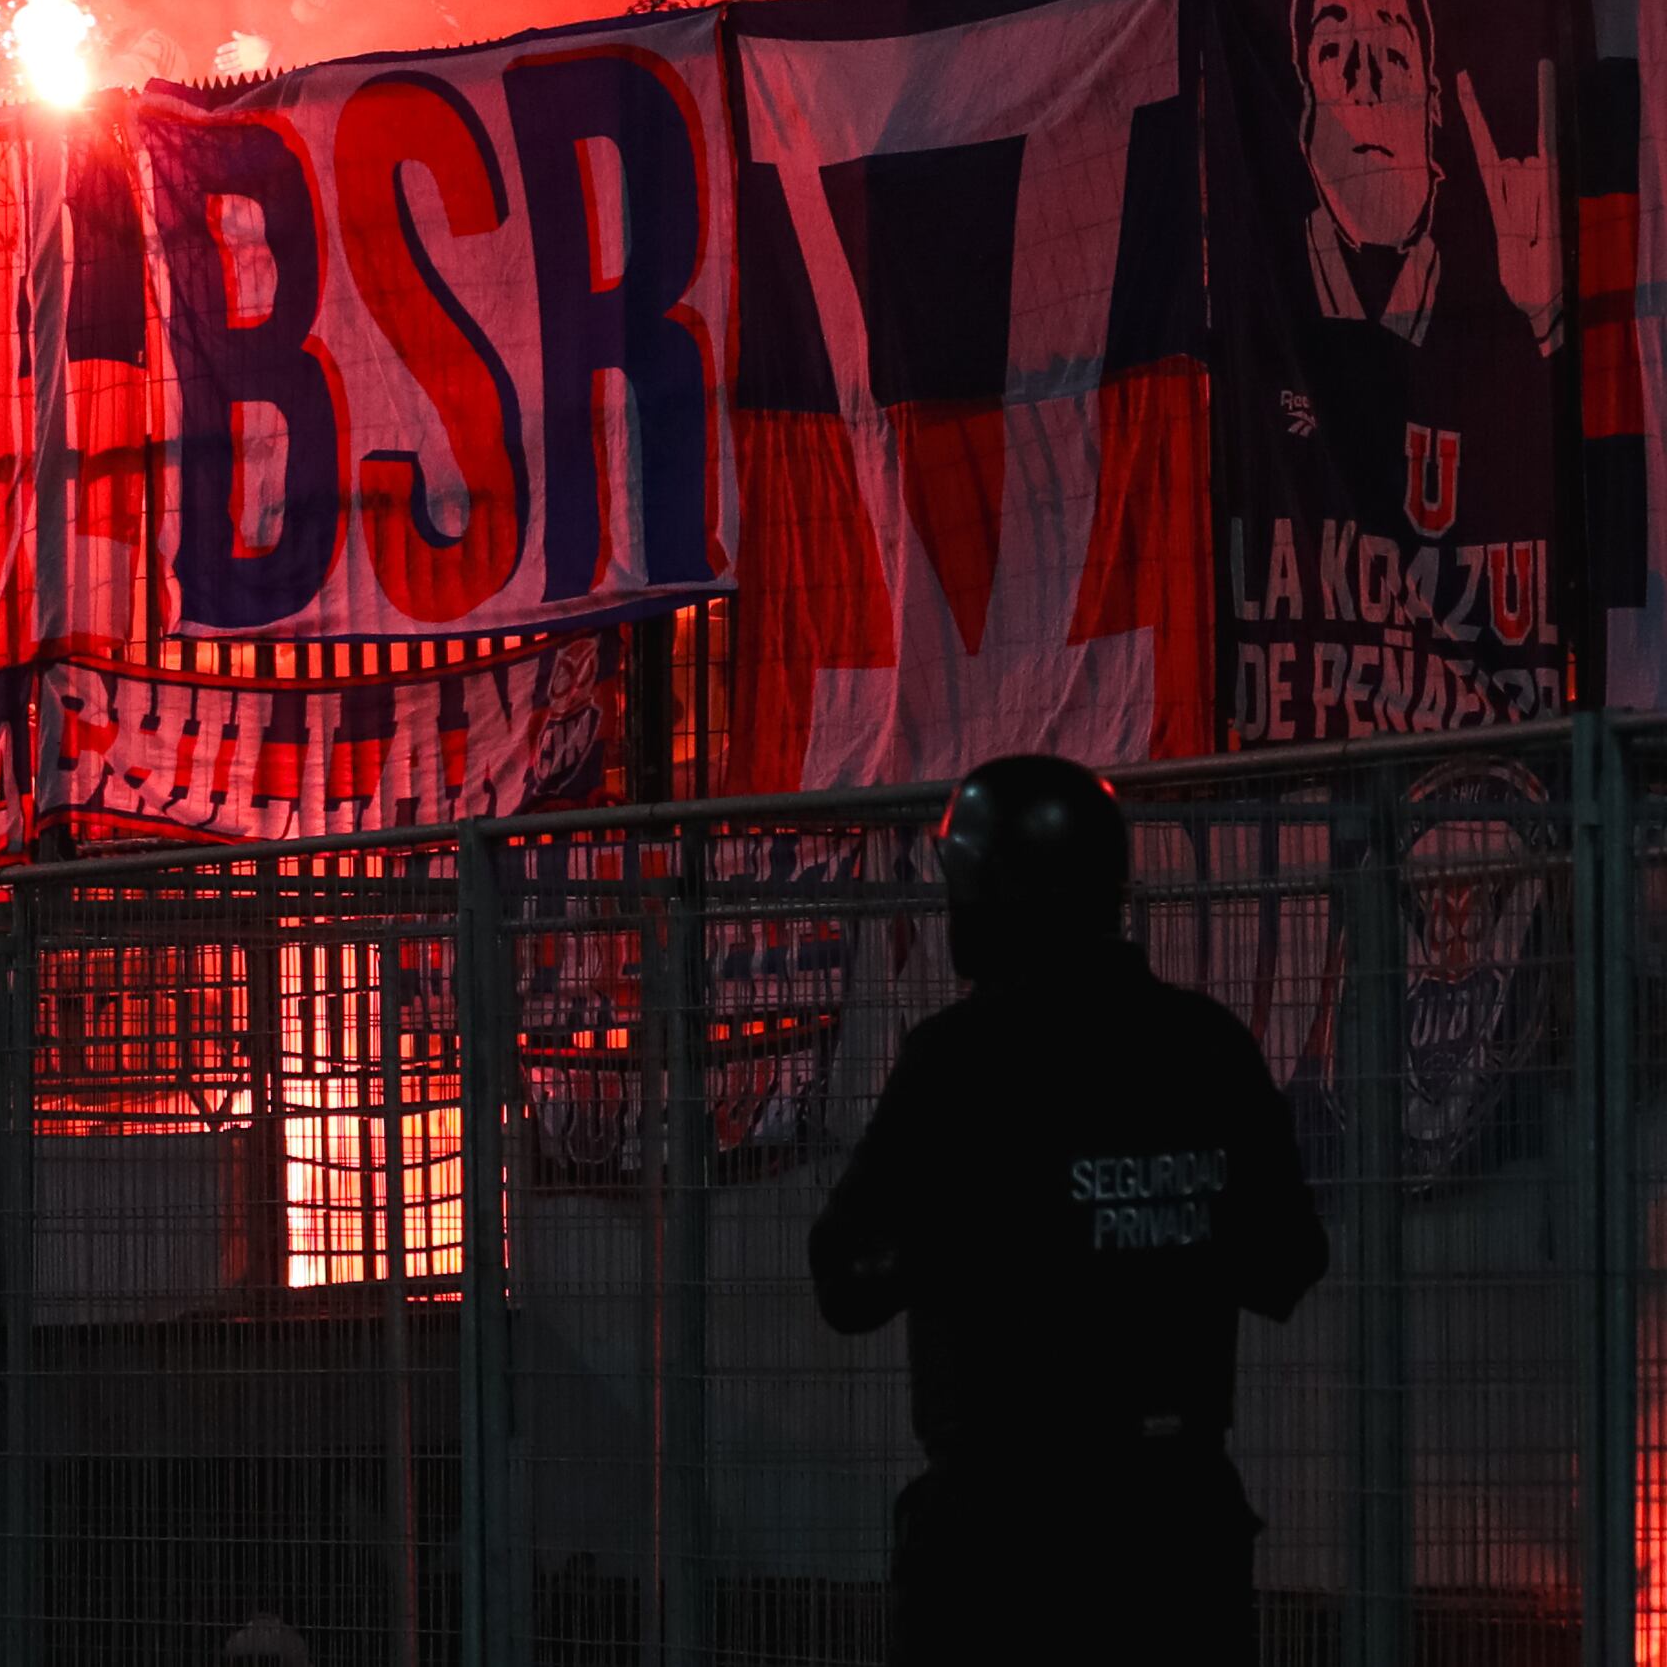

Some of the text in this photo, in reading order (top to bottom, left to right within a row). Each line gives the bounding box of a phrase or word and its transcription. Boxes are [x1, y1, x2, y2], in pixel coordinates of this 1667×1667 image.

[139, 44, 733, 624] BSR
[1404, 422, 1461, 538] U
[1230, 517, 1304, 621] LA
[1236, 641, 1297, 743] DE
[43, 657, 541, 840] CHILLAN
[1071, 1148, 1227, 1203] SEGURIDAD
[1093, 1202, 1213, 1252] PRIVADA
